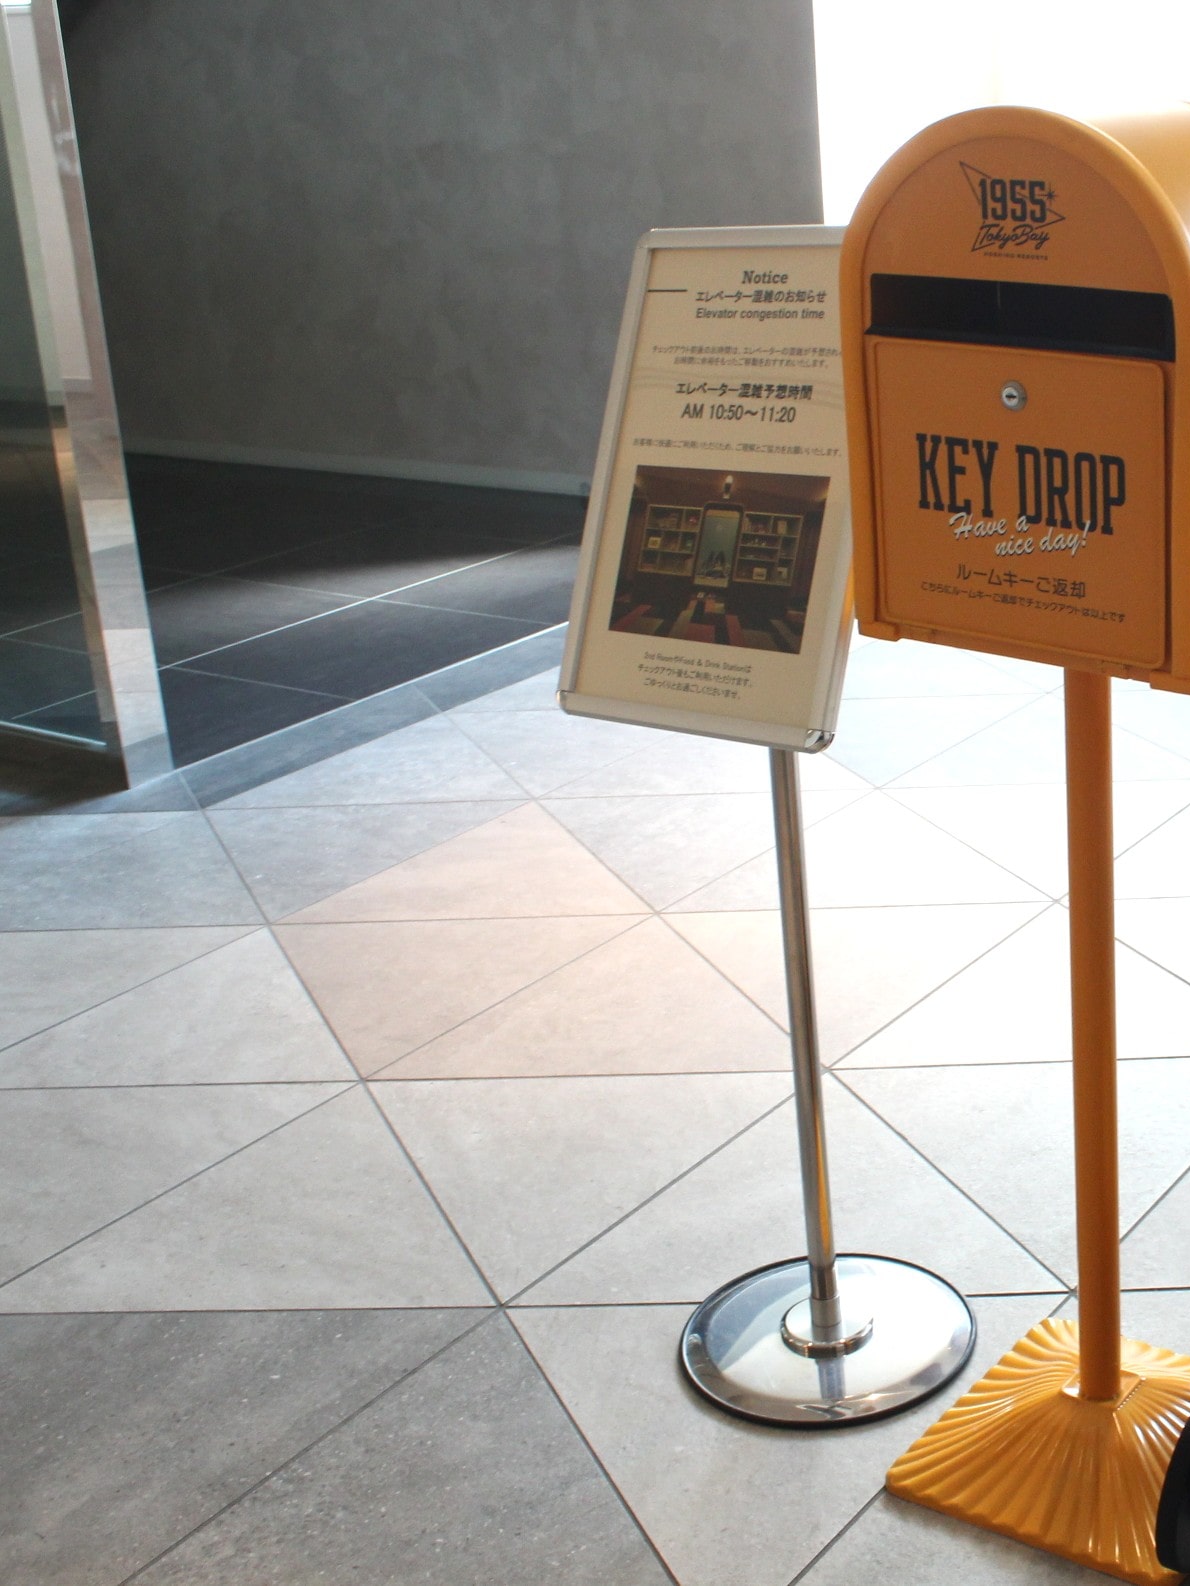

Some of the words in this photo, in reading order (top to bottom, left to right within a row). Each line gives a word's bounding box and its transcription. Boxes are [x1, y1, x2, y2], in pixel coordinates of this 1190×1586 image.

[978, 178, 1047, 223] 1955
[741, 270, 789, 285] Notice
[695, 289, 827, 304] エレベーター混雑のお知らせ
[695, 307, 737, 319] Elevator
[740, 308, 798, 321] congestion
[801, 308, 825, 319] time
[675, 382, 814, 401] エレベーター混雑予想時間
[681, 403, 704, 419] AM
[916, 433, 999, 518] KEY
[1015, 444, 1126, 535] DROP
[948, 511, 1008, 540] Have
[1015, 515, 1031, 532] a
[994, 537, 1035, 558] nice
[1039, 520, 1091, 558] day!
[955, 563, 1087, 600] ルームキーご返却
